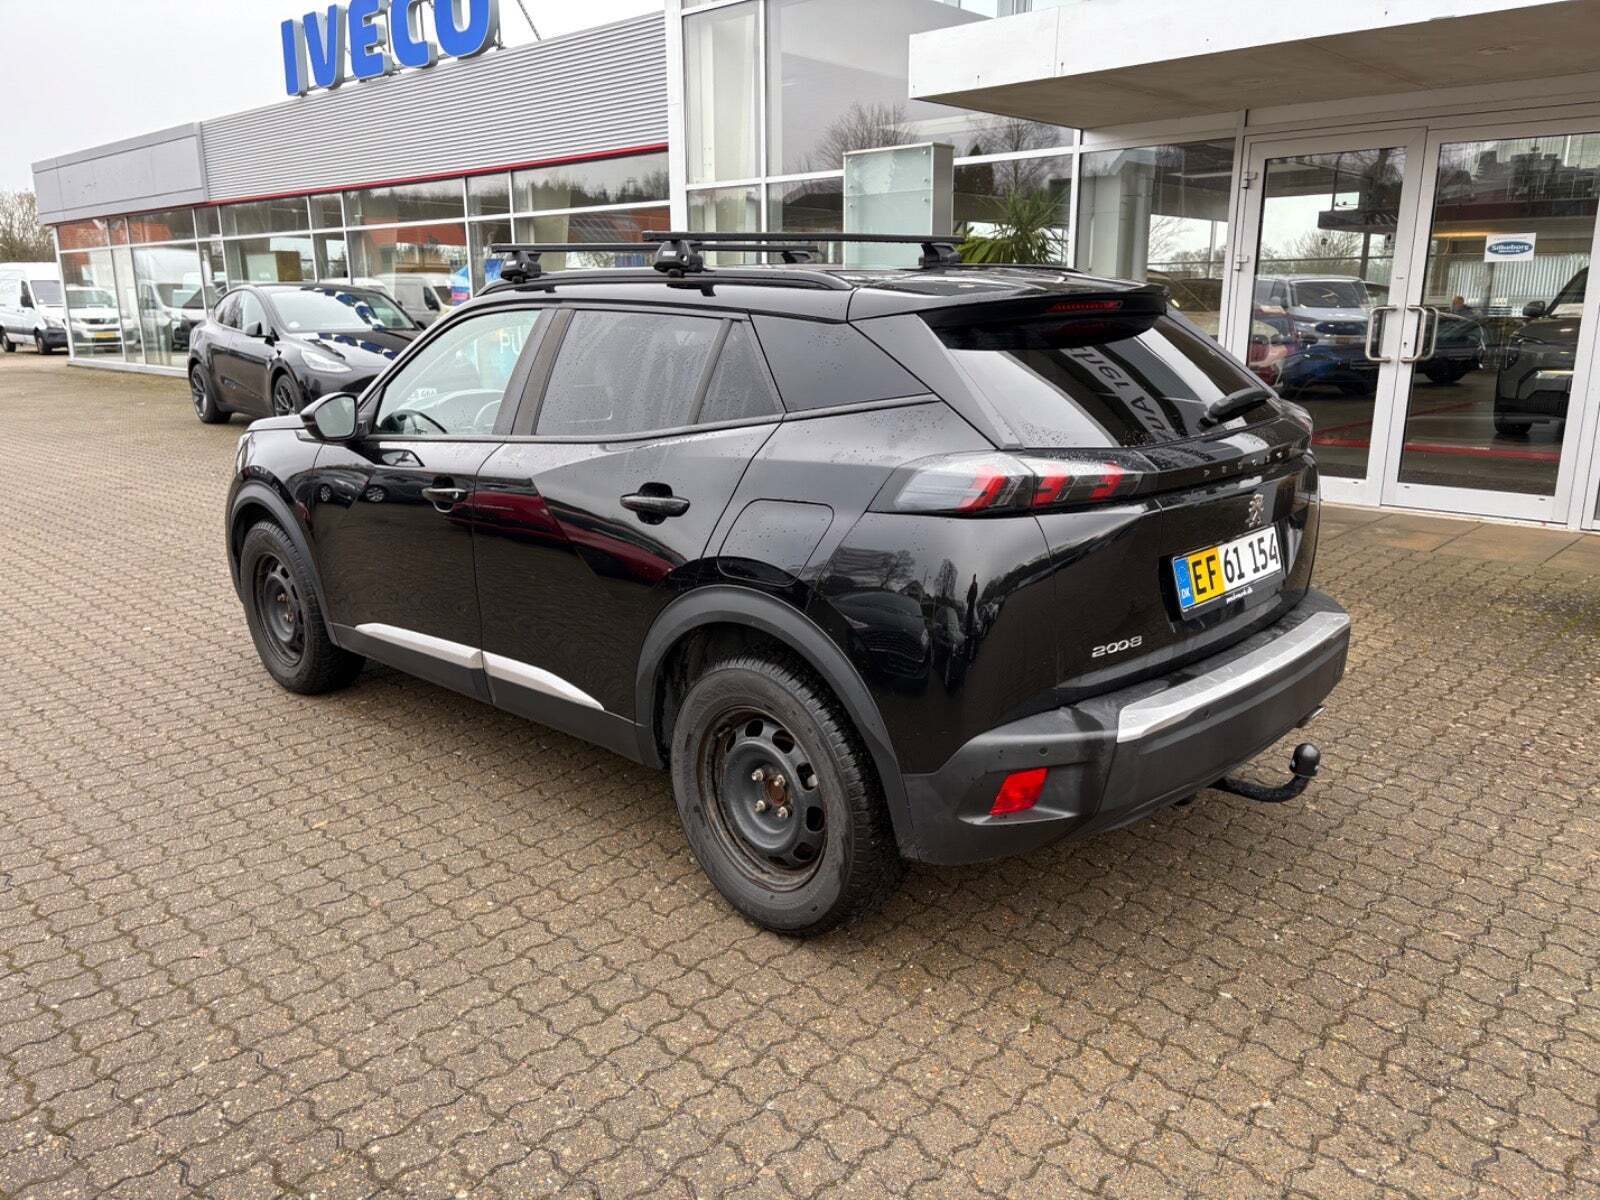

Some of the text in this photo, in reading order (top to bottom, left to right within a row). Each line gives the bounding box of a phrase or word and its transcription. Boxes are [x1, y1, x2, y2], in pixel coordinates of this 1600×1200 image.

[280, 0, 498, 97] IVECO
[1192, 555, 1216, 595] EF
[1223, 546, 1245, 583] 61
[1248, 533, 1279, 574] 154
[1181, 587, 1190, 599] DK
[1091, 635, 1143, 658] 2008
